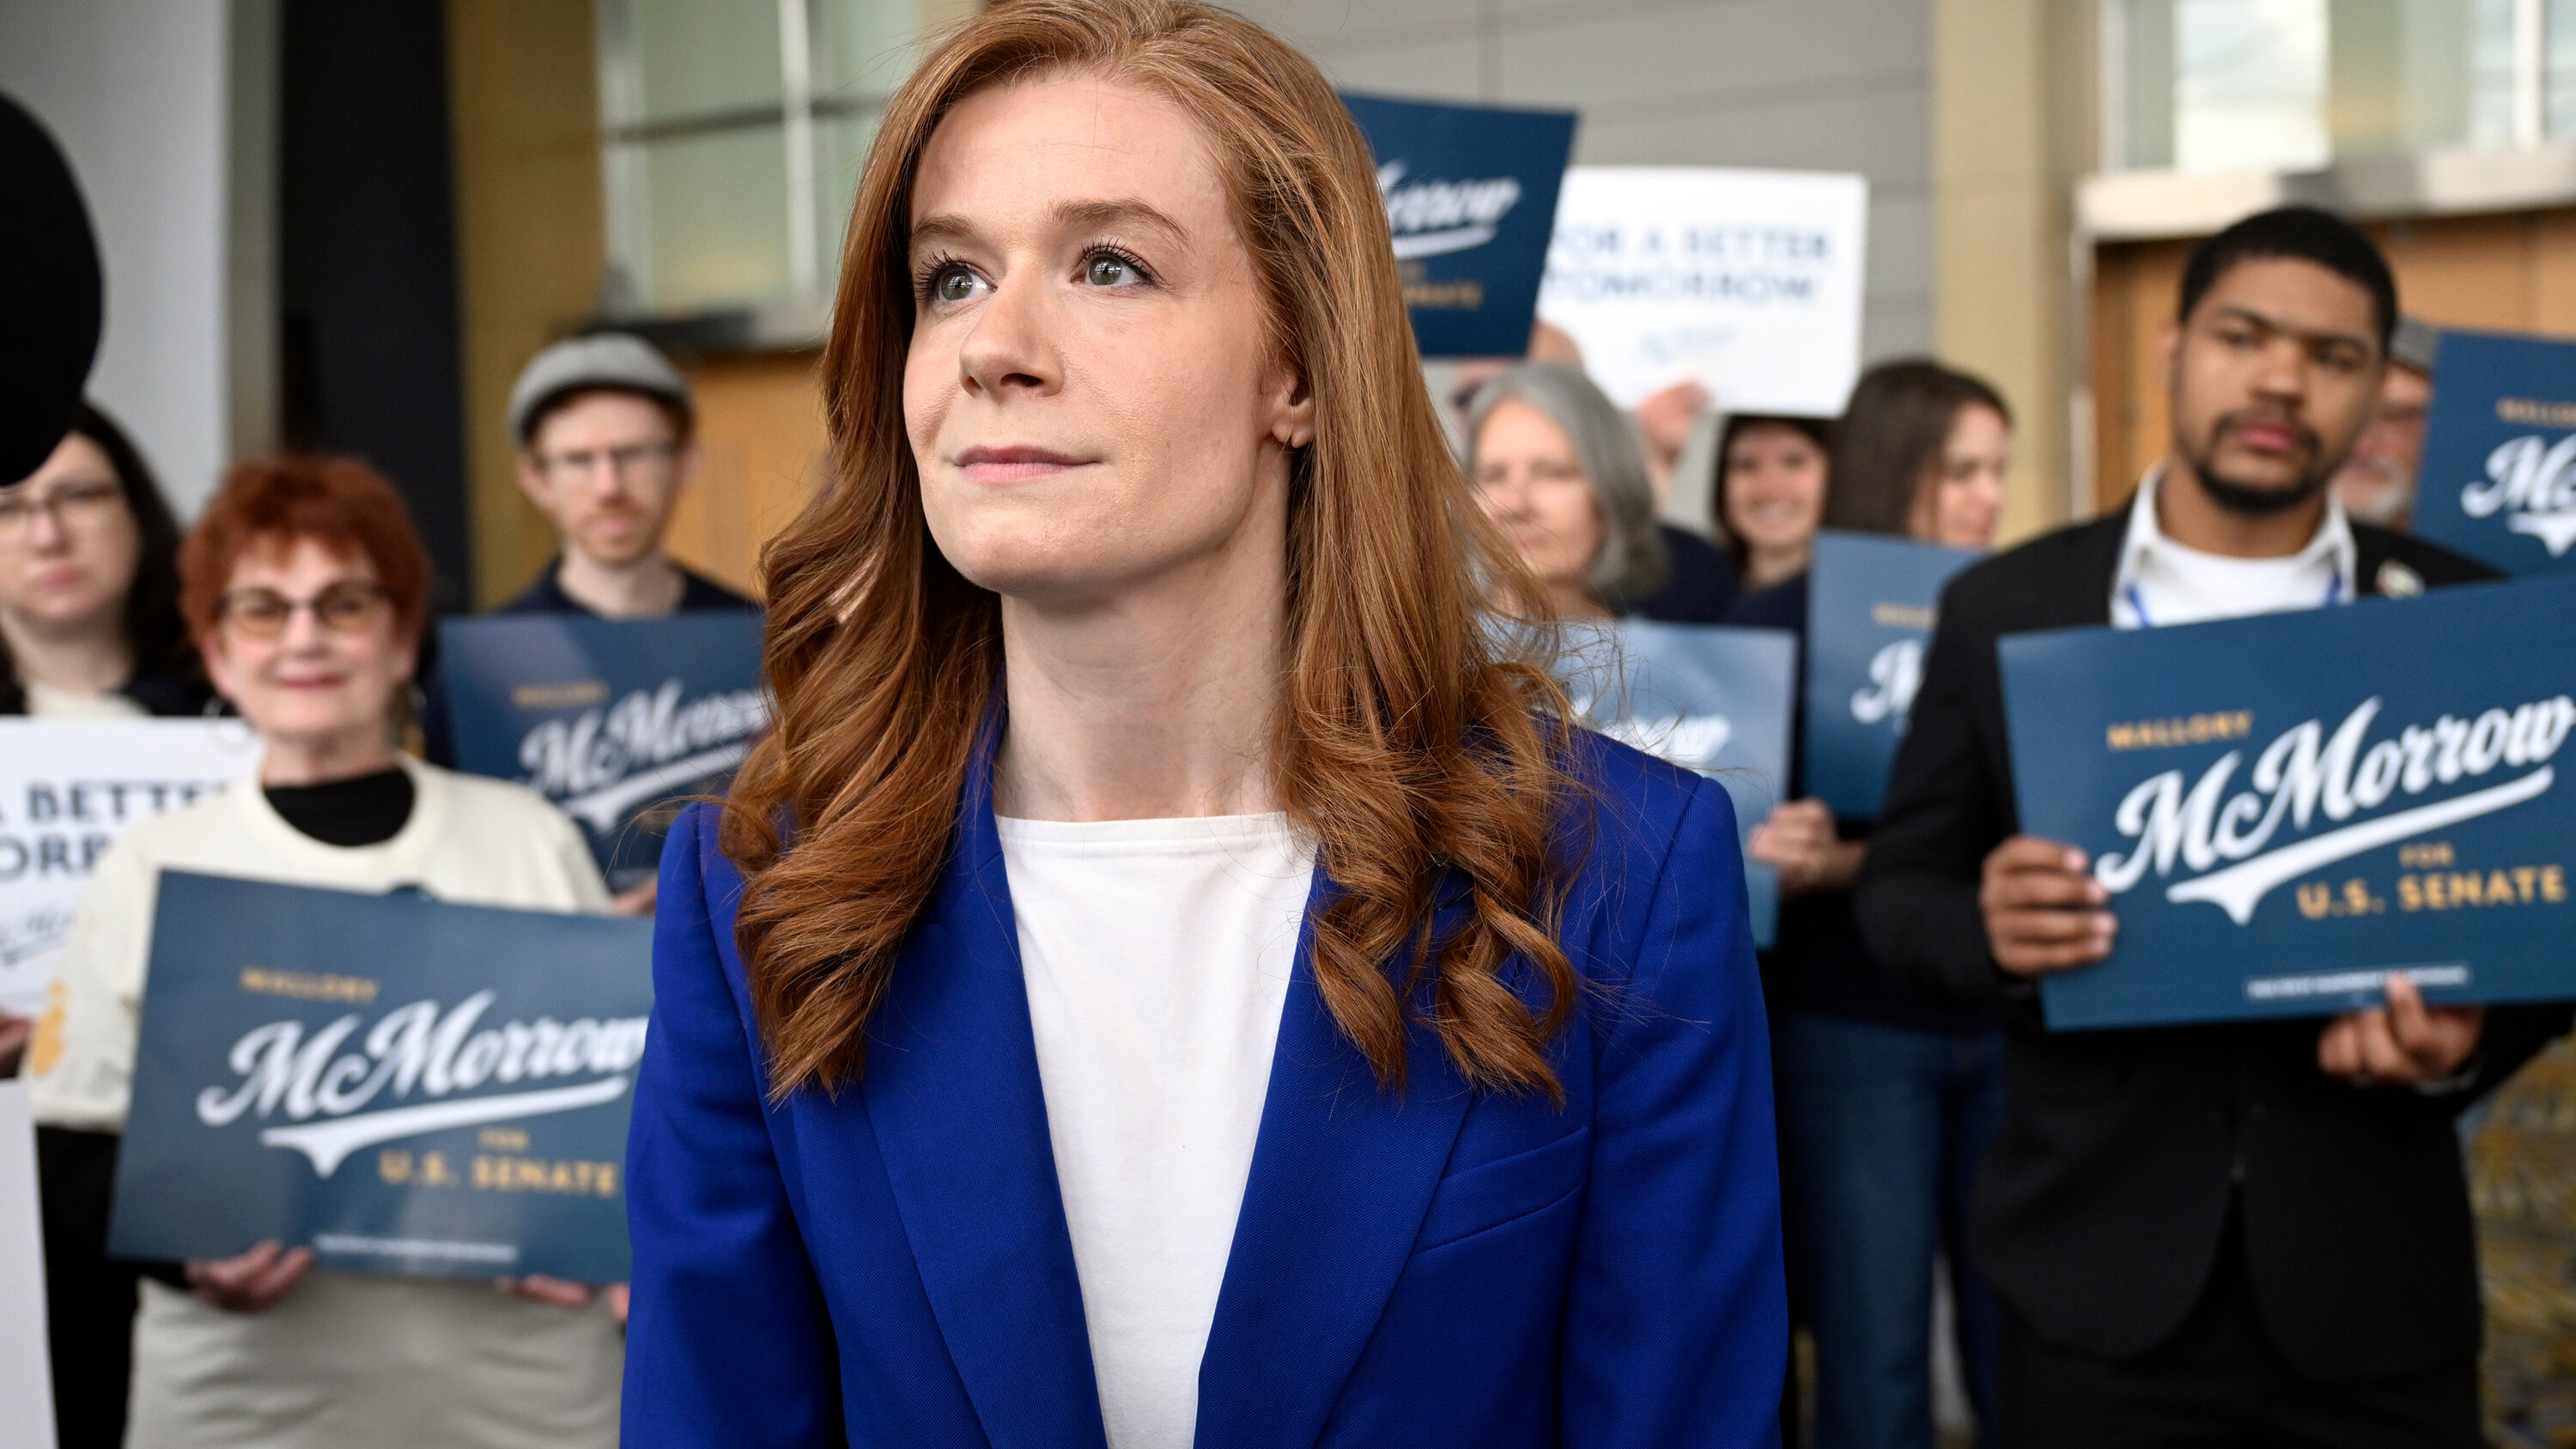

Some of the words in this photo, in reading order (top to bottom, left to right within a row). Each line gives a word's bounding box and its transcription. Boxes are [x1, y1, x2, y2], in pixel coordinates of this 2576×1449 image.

[2106, 709, 2254, 752] MALLORY
[26, 780, 227, 822] BETTE
[2094, 695, 2576, 894] McMorrow
[2399, 843, 2454, 869] FOR
[2297, 881, 2386, 920] U.S.
[2398, 864, 2566, 912] SENATE
[379, 1152, 458, 1187] U.S.
[471, 1155, 618, 1198] SENATE
